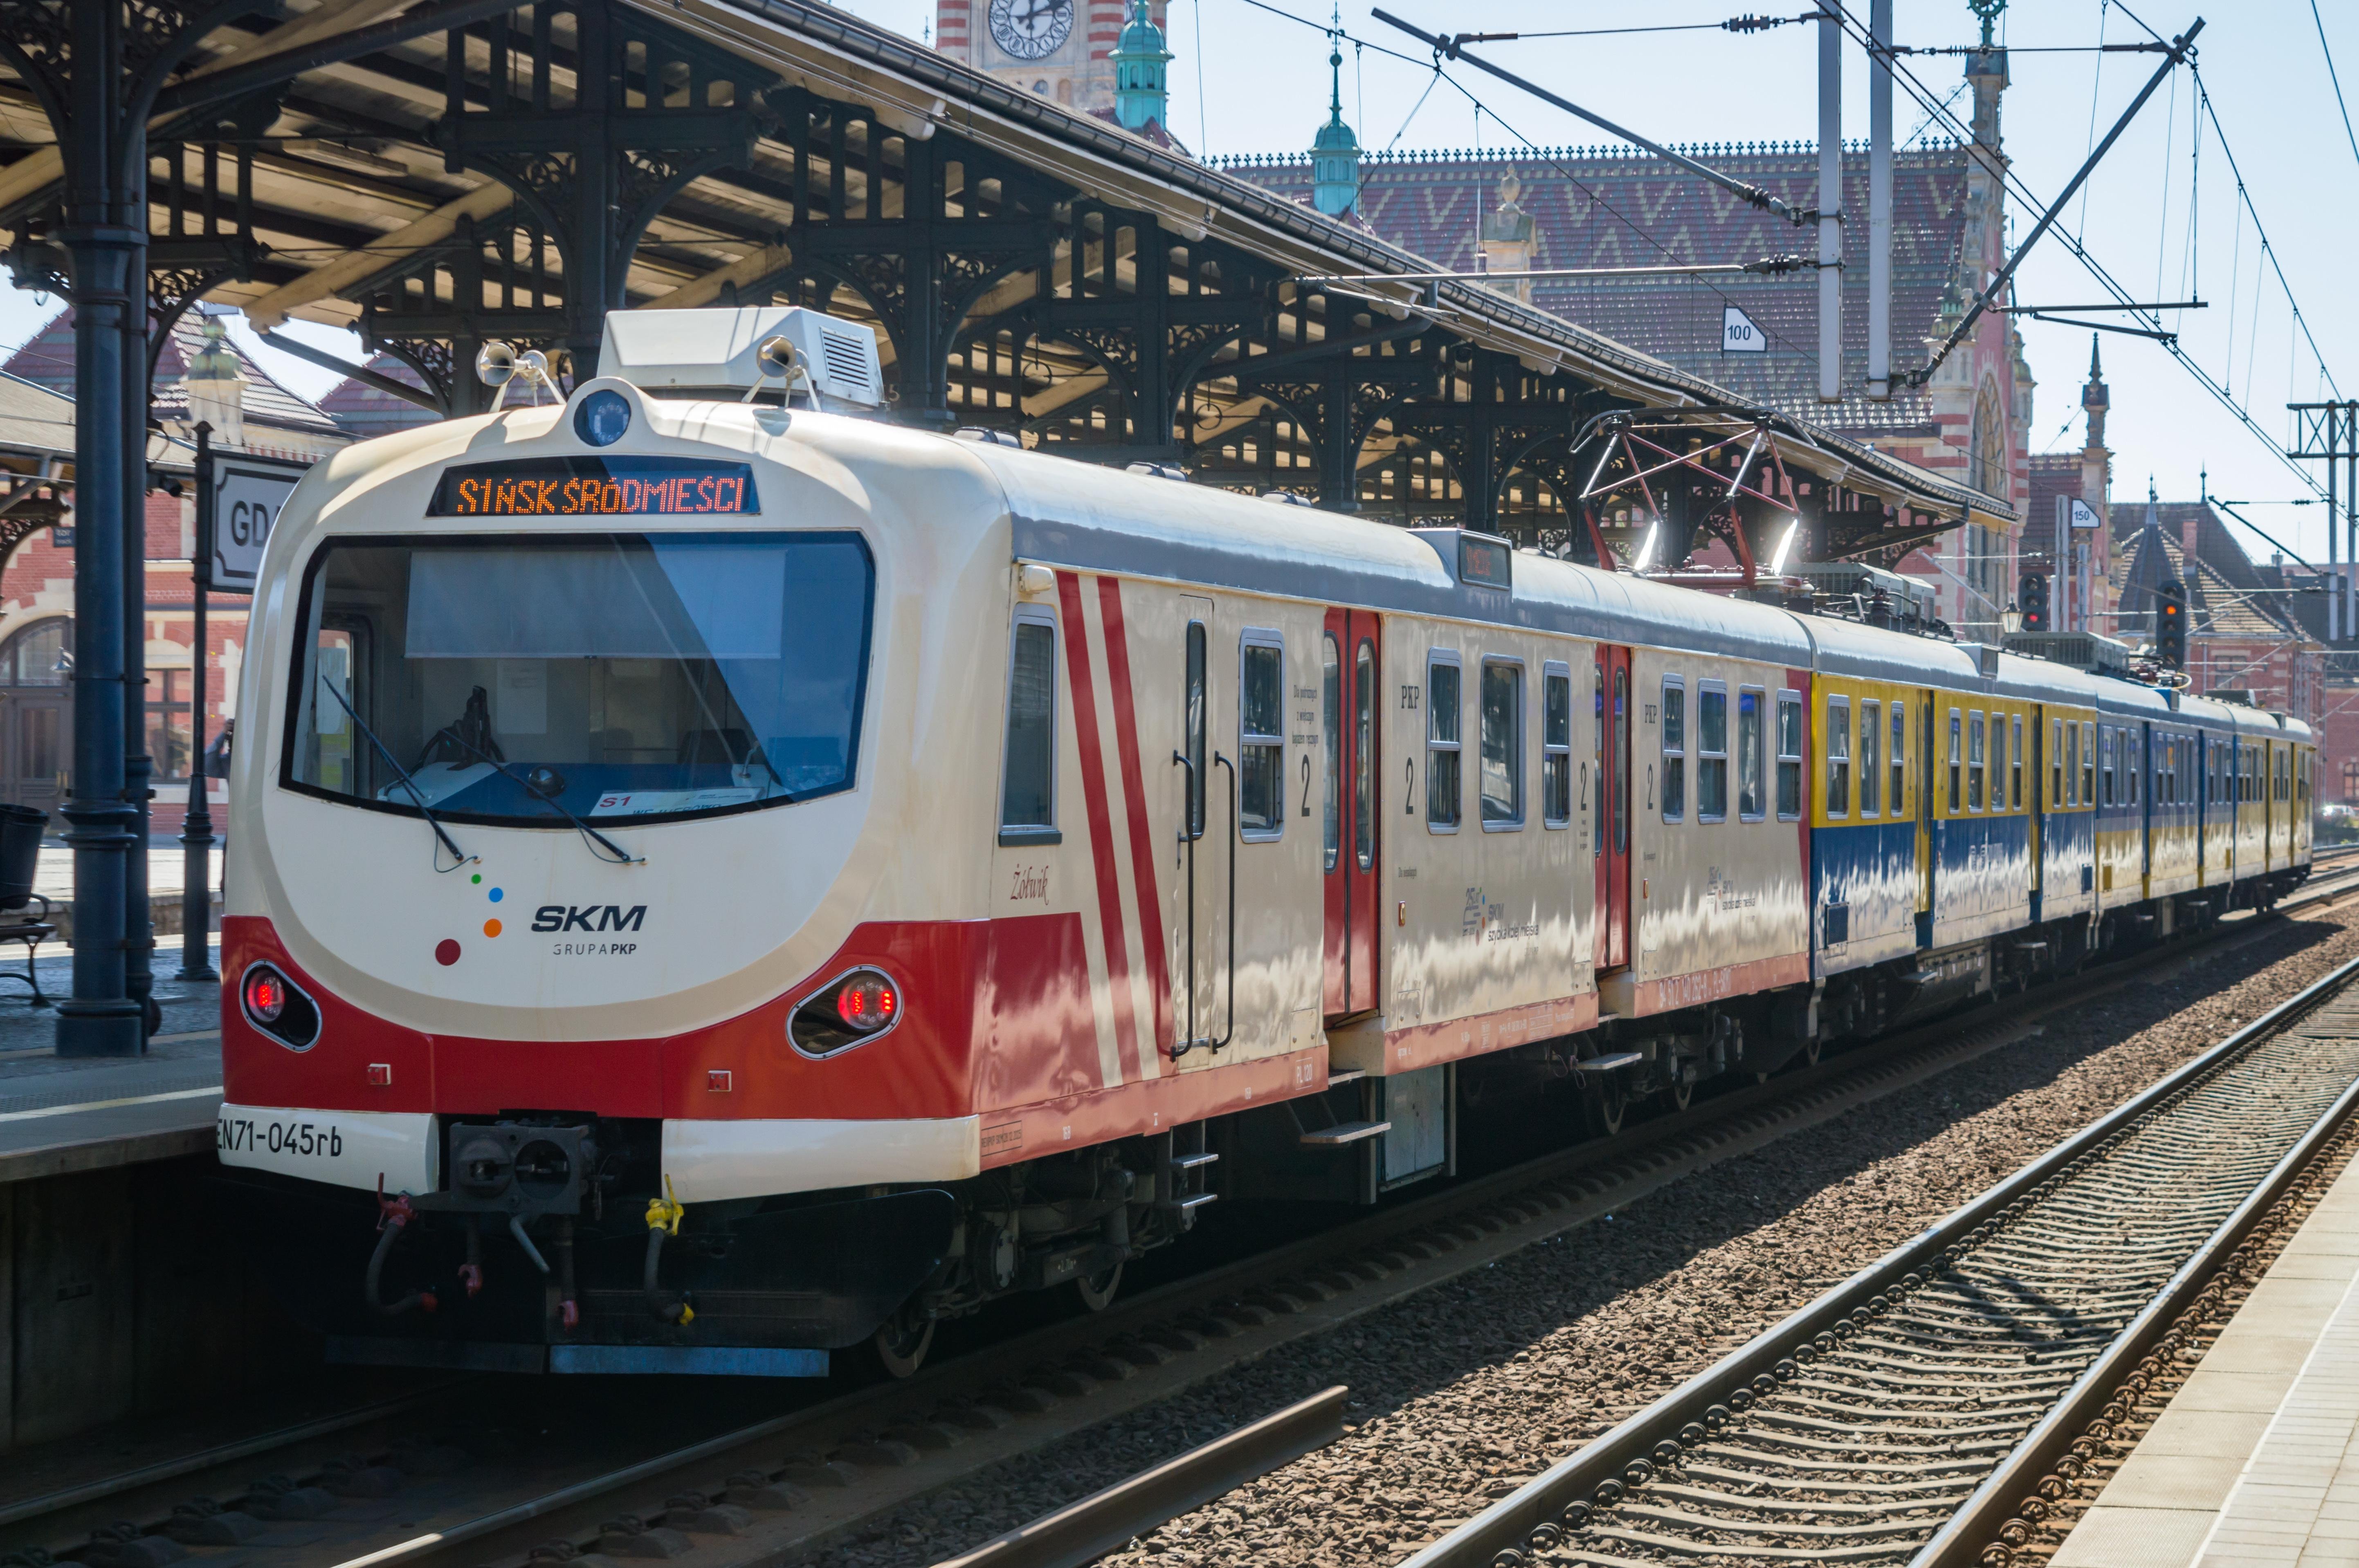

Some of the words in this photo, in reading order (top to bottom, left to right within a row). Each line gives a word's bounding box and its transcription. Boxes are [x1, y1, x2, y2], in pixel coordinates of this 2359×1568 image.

[1727, 325, 1751, 340] 100
[562, 476, 744, 514] ŚRÓDMIEŚCI
[231, 500, 281, 547] GD
[2074, 510, 2089, 520] 150
[1401, 685, 1420, 709] PKP
[1645, 704, 1657, 724] PKP
[1301, 754, 1310, 817] 2
[1406, 757, 1414, 815] 2
[1580, 761, 1586, 811] 2
[1647, 763, 1653, 810] 2
[600, 796, 631, 808] S1
[1010, 864, 1049, 905] Żółwik
[531, 905, 648, 932] SKM
[1488, 903, 1505, 922] SKM
[553, 944, 608, 955] GRUPA
[610, 943, 637, 955] PKP
[217, 1119, 341, 1157] EN71-045rb
